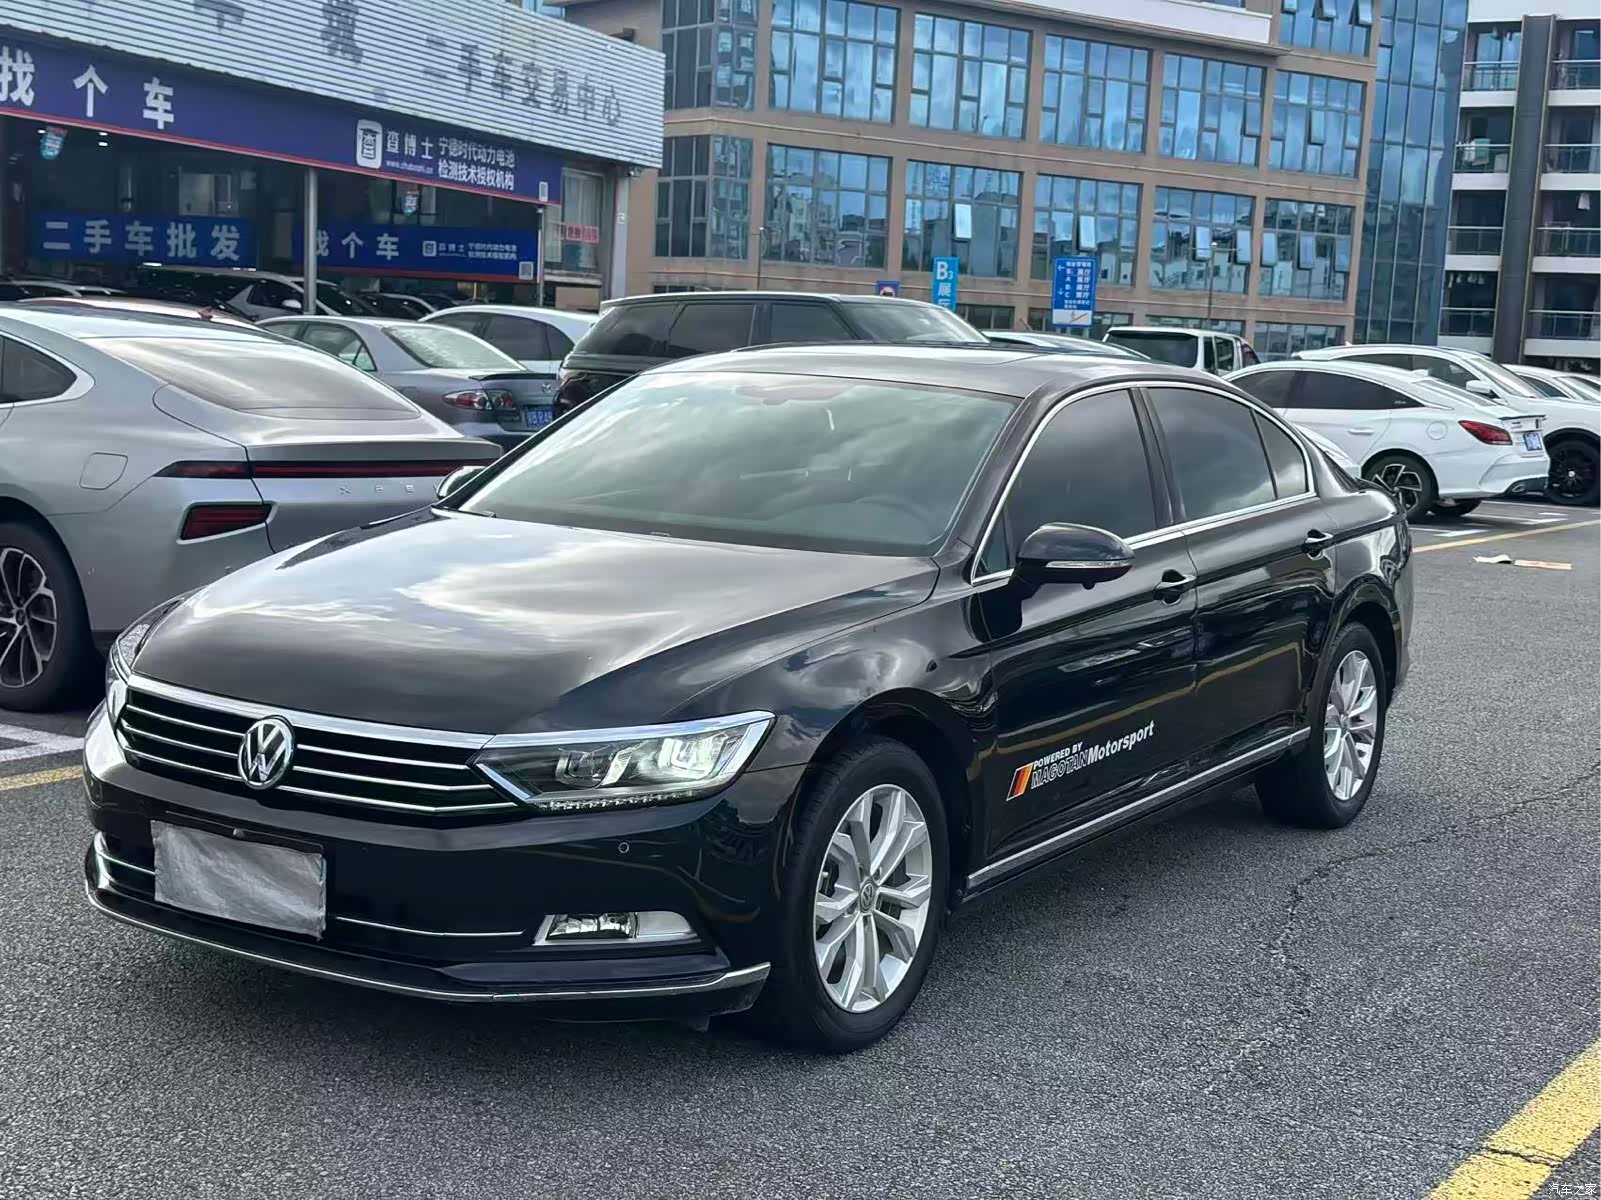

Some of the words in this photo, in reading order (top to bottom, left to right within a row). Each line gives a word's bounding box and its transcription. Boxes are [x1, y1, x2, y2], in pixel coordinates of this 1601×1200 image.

[0, 46, 174, 129] 找个车
[423, 35, 622, 126] 二手车交易中心
[439, 136, 516, 169] 宁德时代动力电池
[438, 158, 516, 191] 检测技术授权机构
[43, 219, 240, 261] 二手车批发
[936, 261, 953, 280] B3
[1033, 749, 1071, 770] POWERED
[1072, 741, 1083, 755] BY
